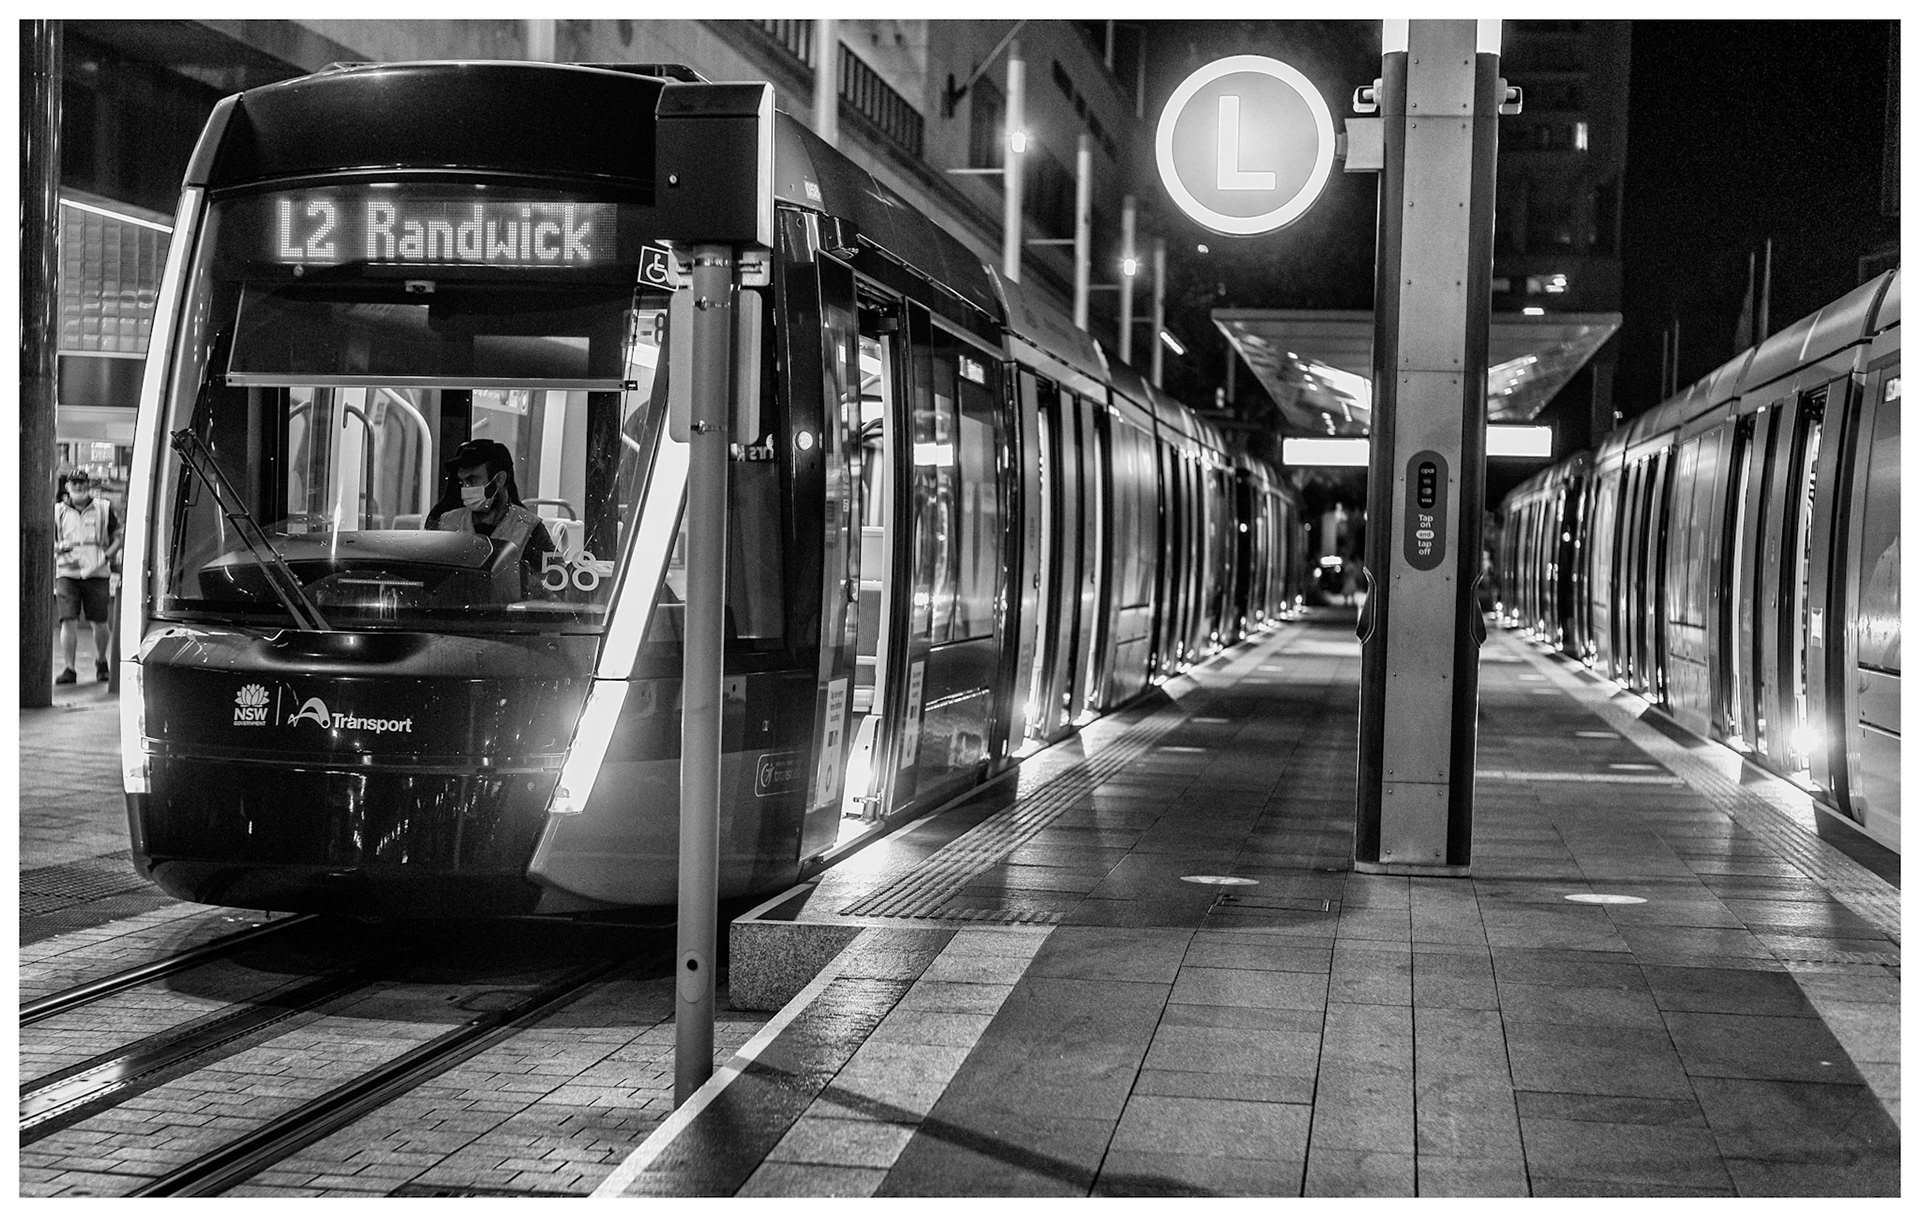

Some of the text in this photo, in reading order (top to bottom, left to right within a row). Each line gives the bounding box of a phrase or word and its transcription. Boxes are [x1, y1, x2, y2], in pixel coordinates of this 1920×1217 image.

[1217, 95, 1276, 190] L
[280, 200, 591, 261] L2 Randwick
[1418, 514, 1434, 523] Tap
[1418, 540, 1432, 549] tap
[1418, 548, 1431, 556] off
[541, 550, 600, 591] 58
[233, 707, 268, 721] NSW
[331, 712, 412, 734] Transport
